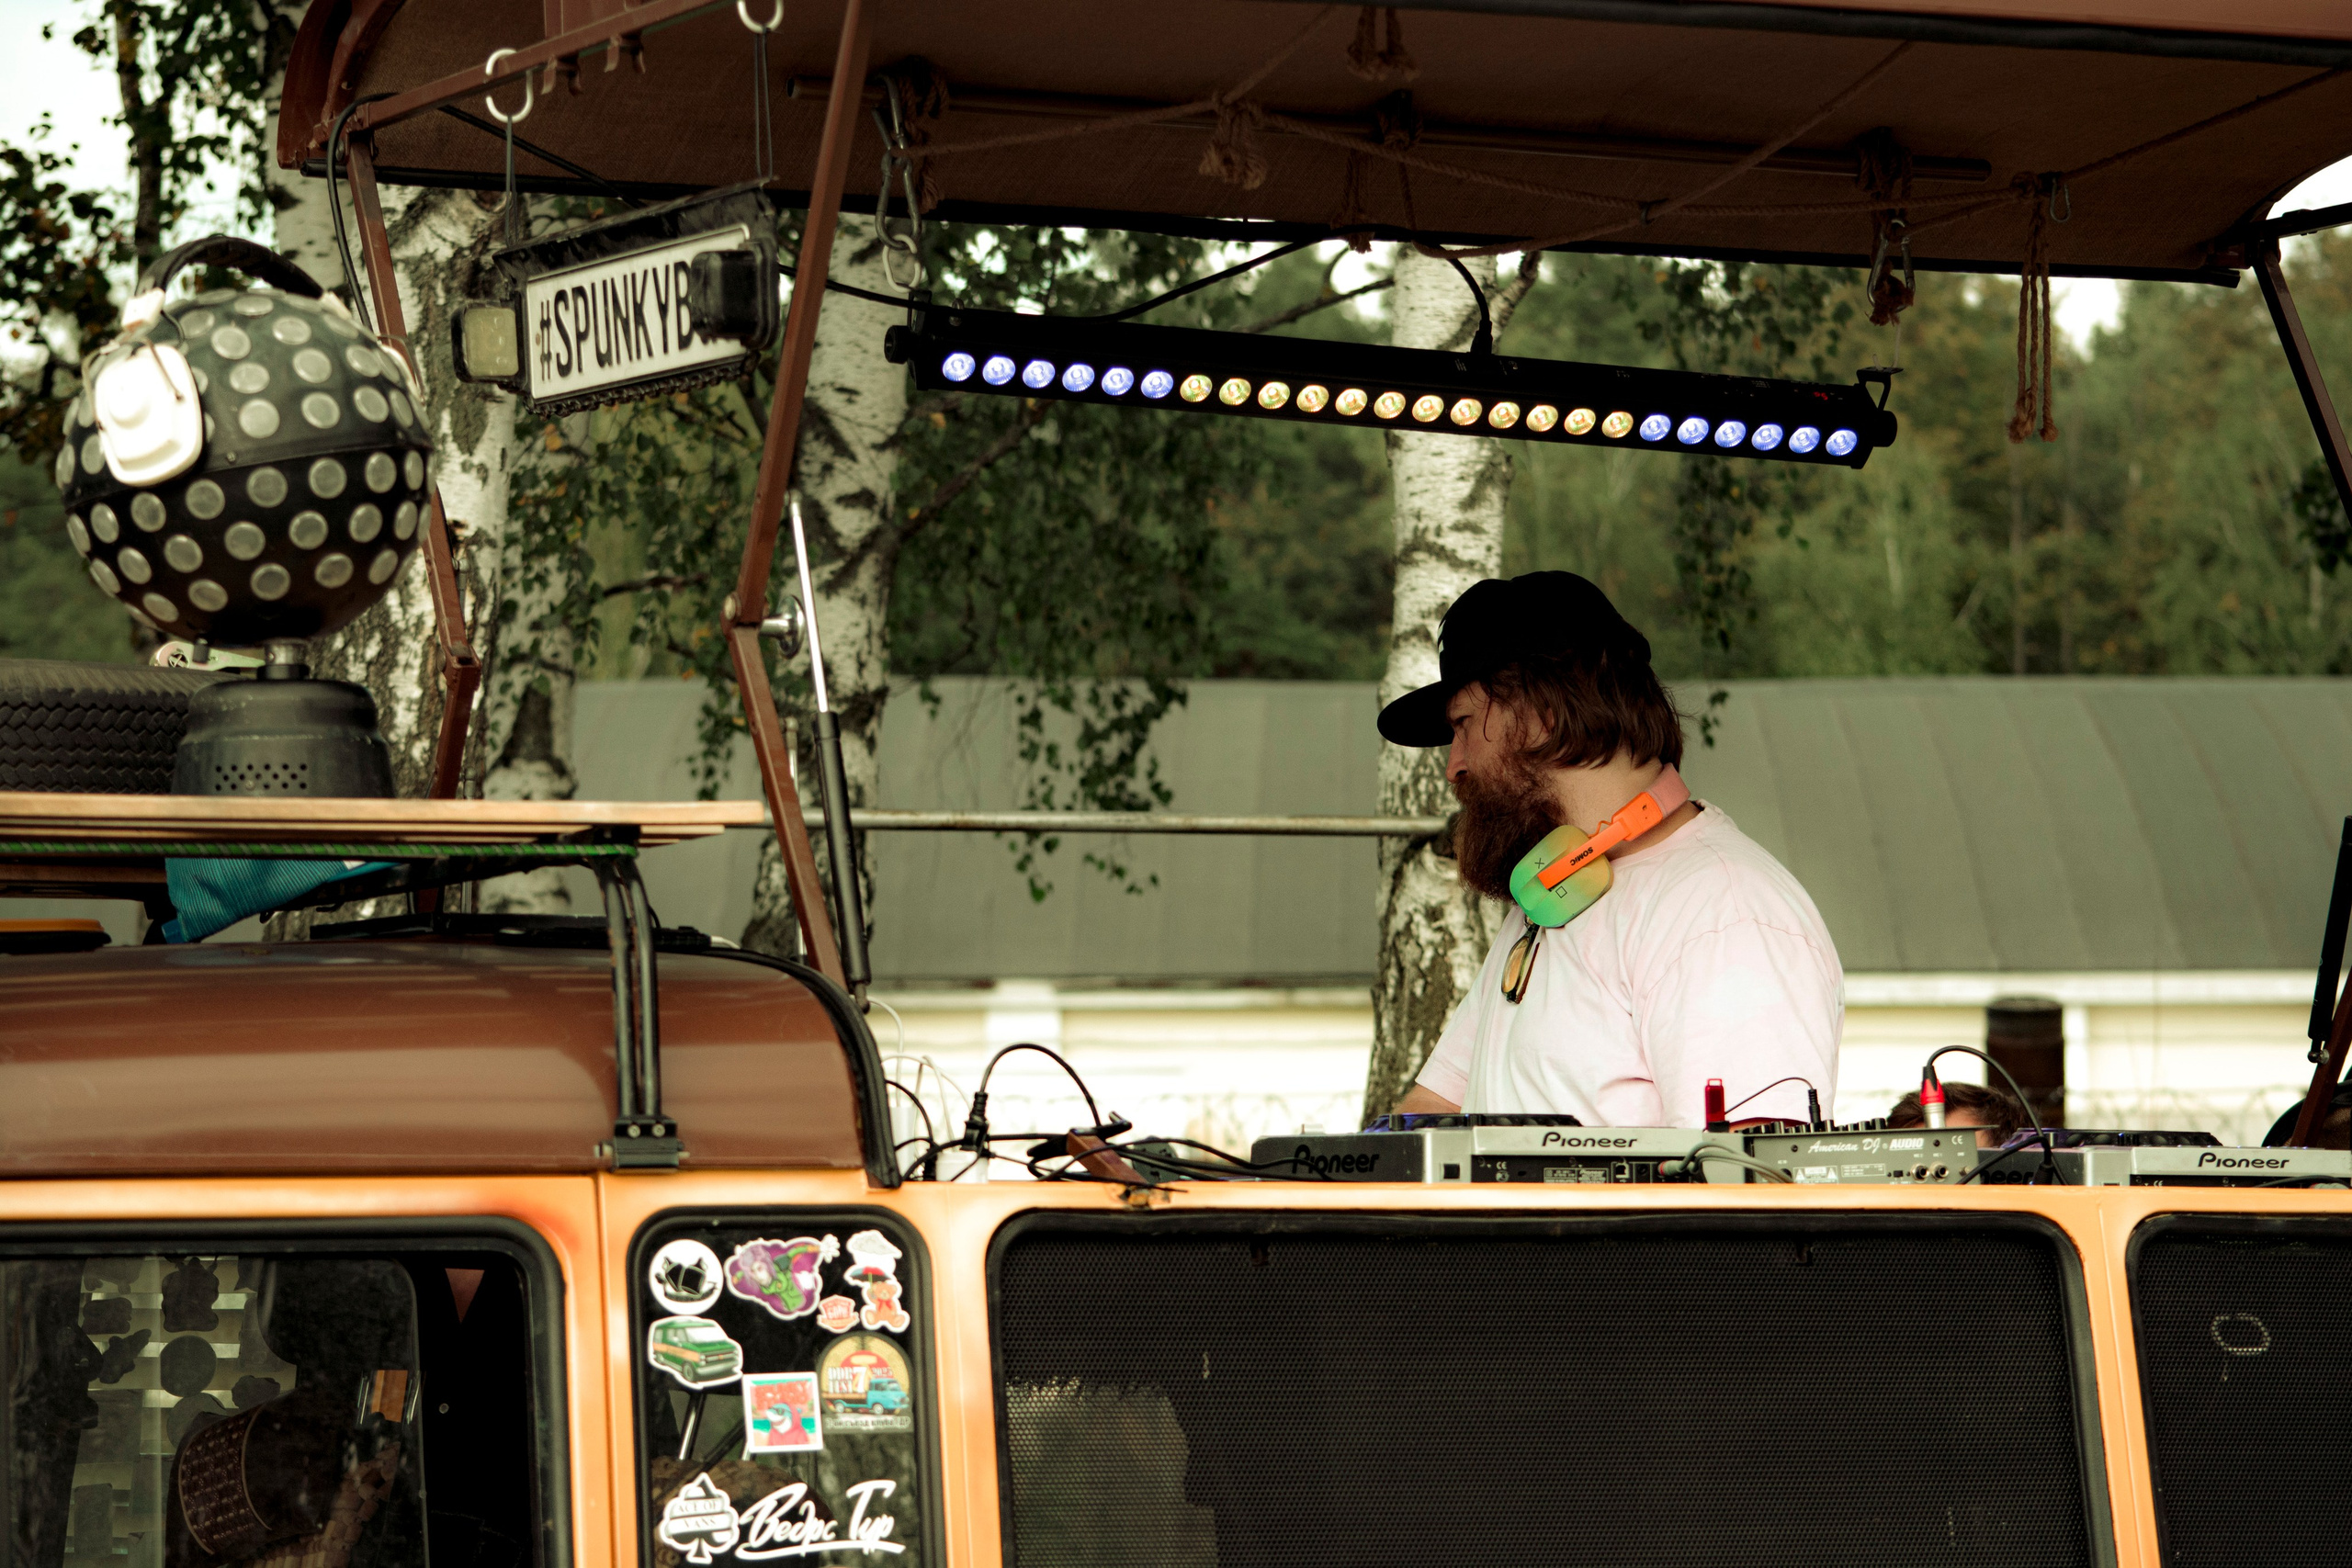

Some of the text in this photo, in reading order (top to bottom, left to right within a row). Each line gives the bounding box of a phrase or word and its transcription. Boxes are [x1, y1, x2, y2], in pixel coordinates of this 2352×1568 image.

[1542, 1131, 1638, 1148] Pioneer
[1807, 1137, 1925, 1154] American DJ AUDIO
[1291, 1144, 1380, 1174] Pioneer
[2198, 1151, 2290, 1170] Pioneer
[853, 1366, 868, 1393] 7
[678, 1499, 717, 1512] ACE OF
[683, 1516, 717, 1528] VANS
[845, 1479, 897, 1556] Тур
